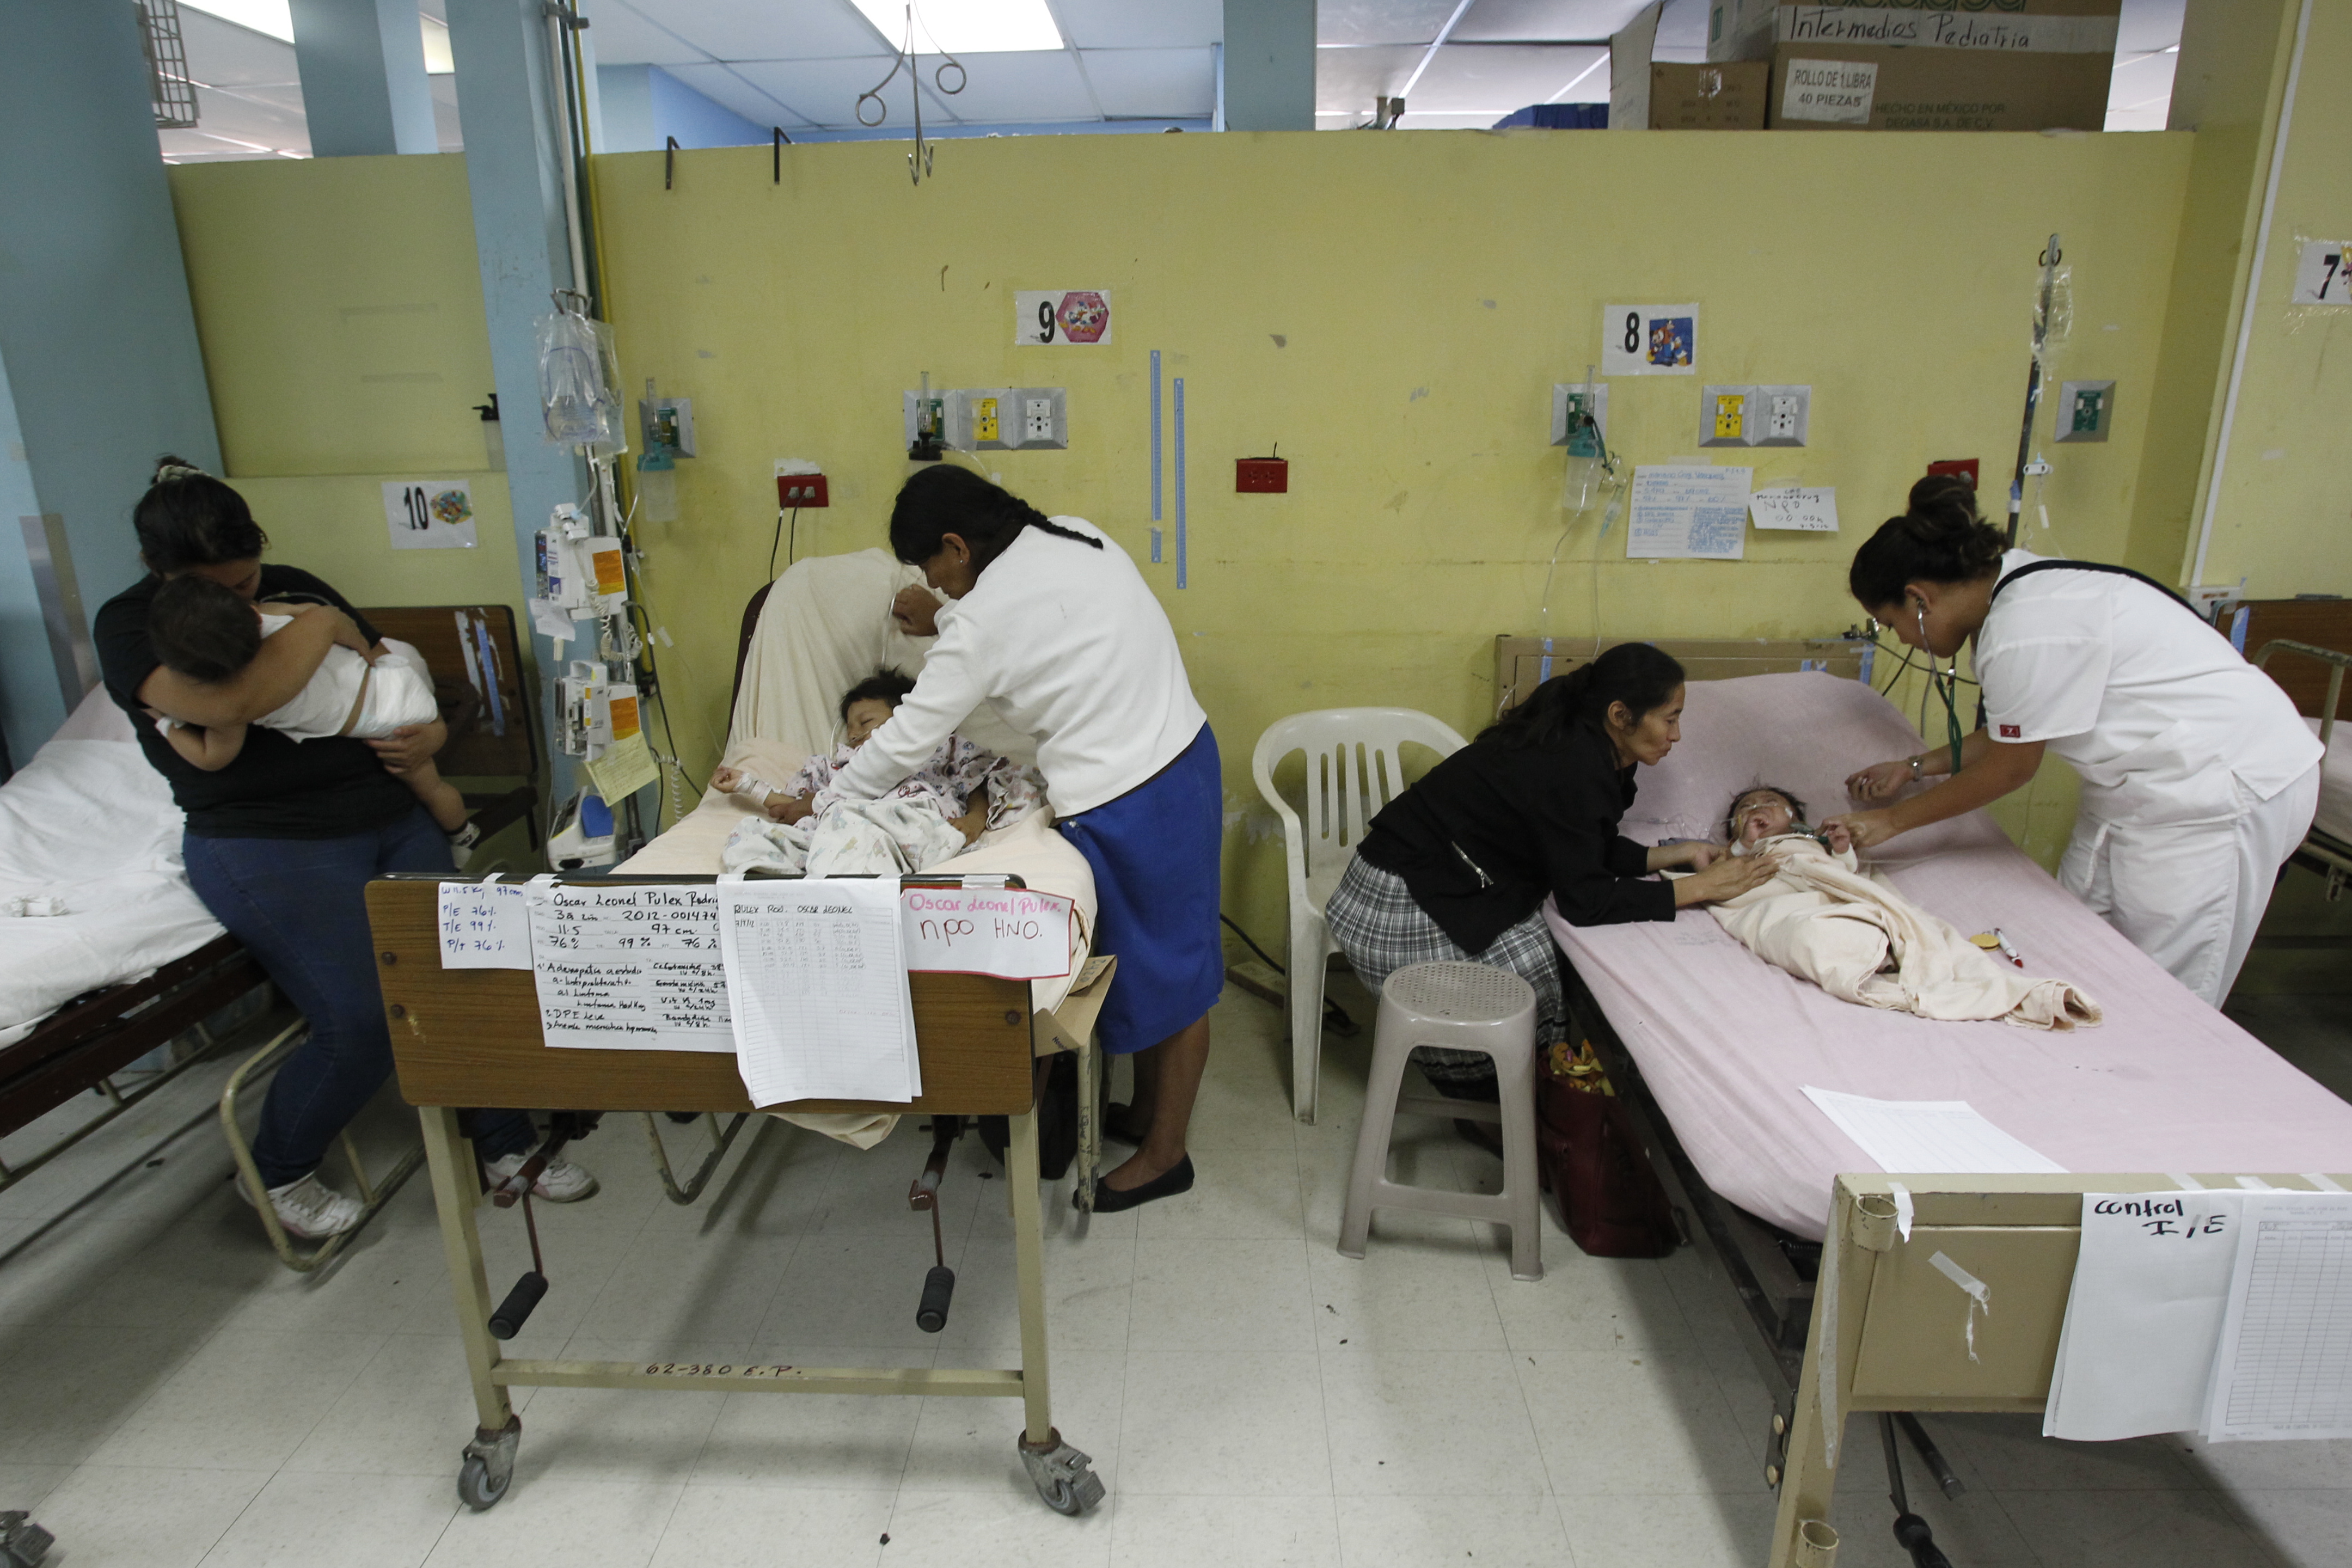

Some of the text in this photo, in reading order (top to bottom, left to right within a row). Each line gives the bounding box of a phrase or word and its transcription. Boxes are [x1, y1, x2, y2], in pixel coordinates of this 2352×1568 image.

[1794, 69, 1824, 87] ROLLO
[1825, 70, 1838, 88] DE
[1846, 72, 1871, 89] LIBRA
[1798, 93, 1862, 107] 40 PIEZAS
[2319, 254, 2341, 299] 7
[1039, 301, 1055, 343] 9
[1625, 311, 1640, 353] 8
[404, 486, 428, 530] 10
[553, 892, 586, 906] Oscar
[645, 892, 682, 906] Pulex
[909, 893, 961, 911] Oscar
[646, 1363, 732, 1375] 62-380
